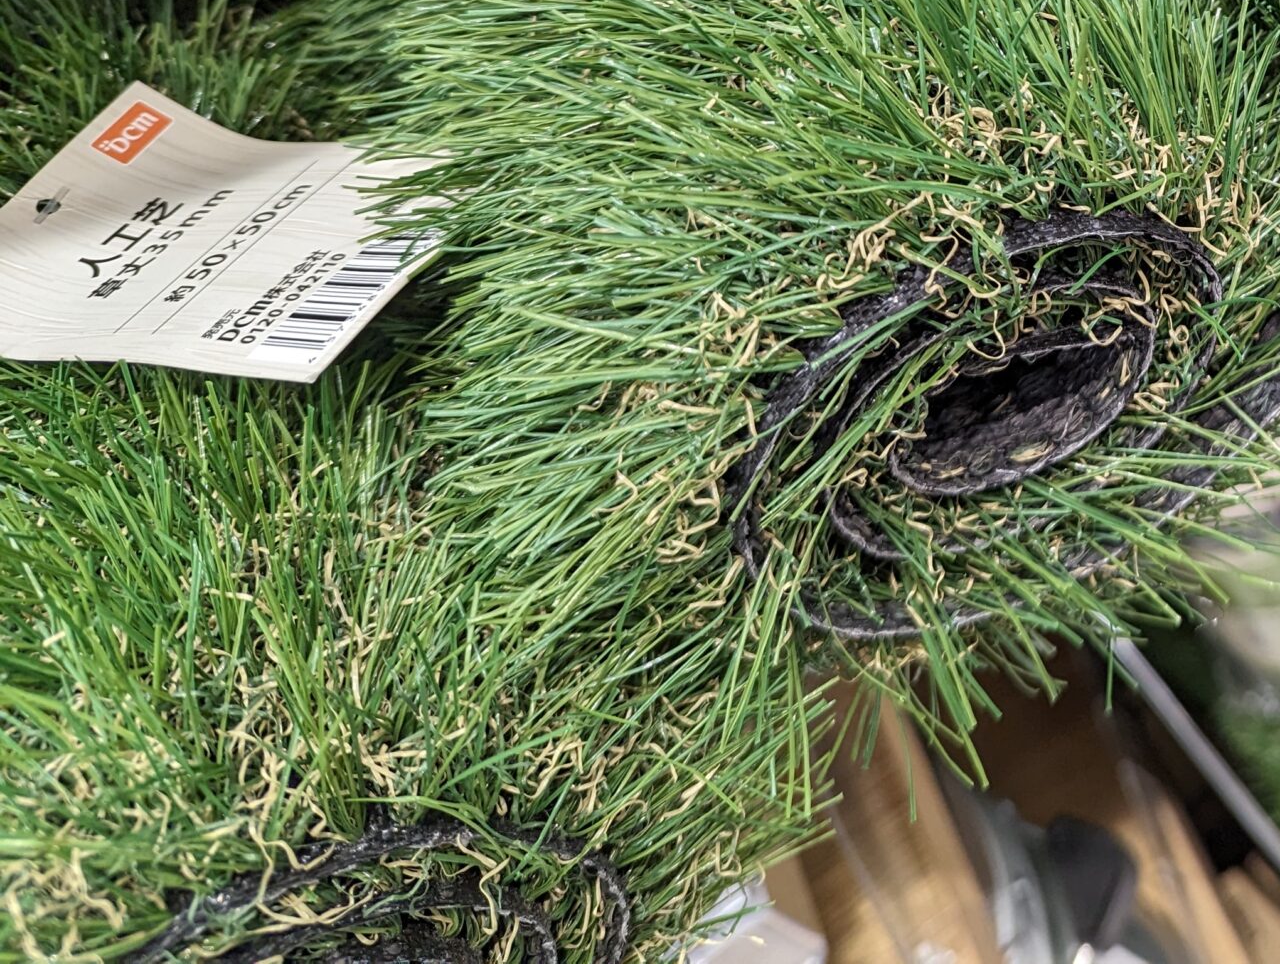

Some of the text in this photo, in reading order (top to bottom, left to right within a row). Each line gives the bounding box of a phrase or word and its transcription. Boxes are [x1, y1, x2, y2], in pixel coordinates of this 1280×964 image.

[78, 197, 184, 278] 人工芝
[87, 190, 235, 299] 草丈35mm
[240, 253, 346, 344] 0120-042110
